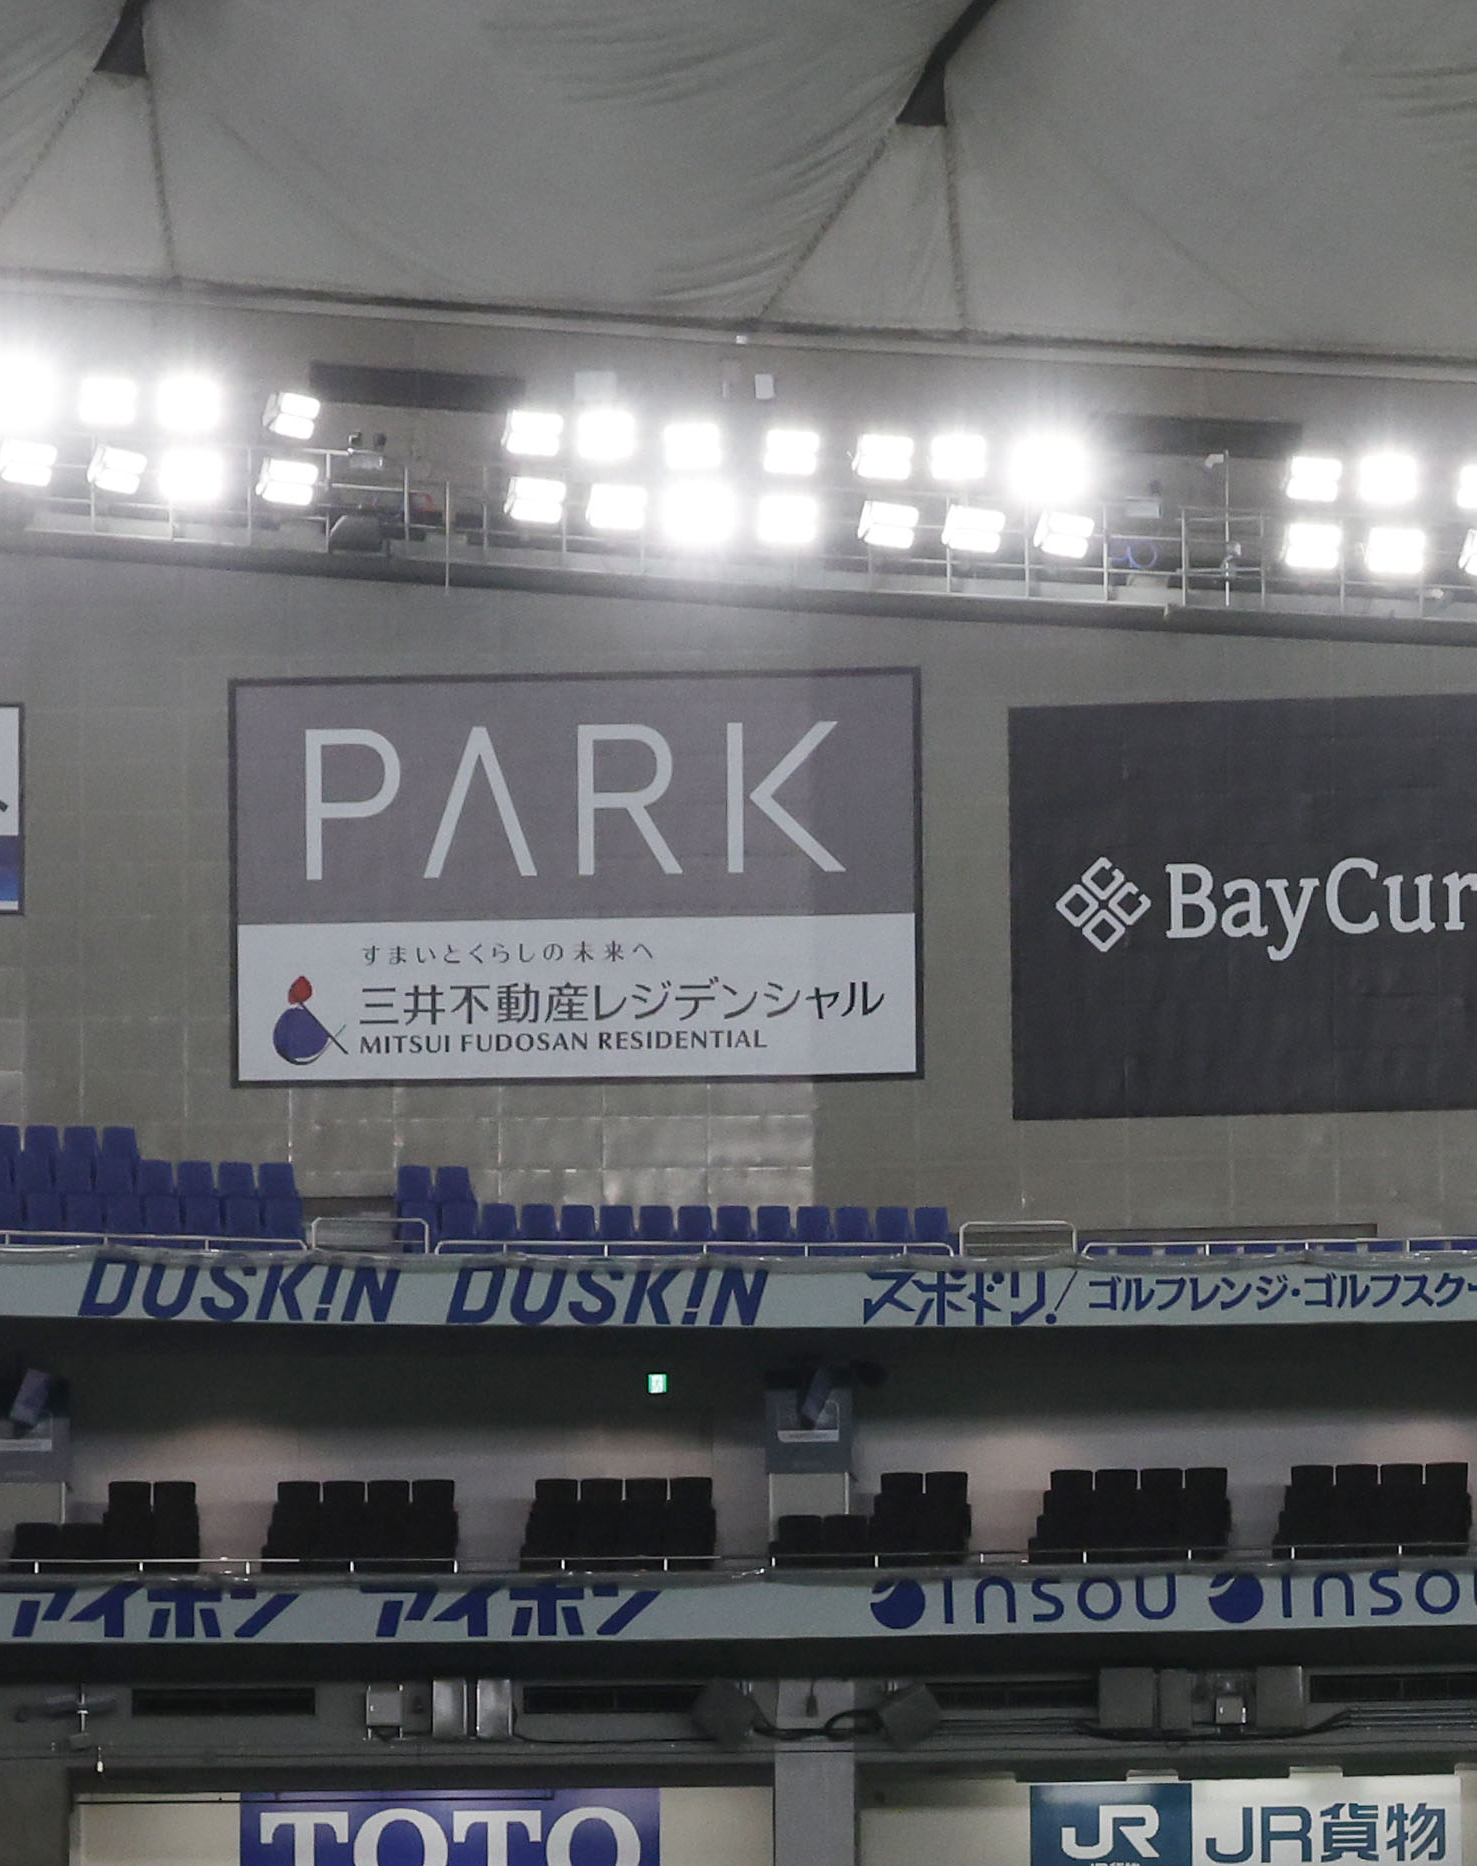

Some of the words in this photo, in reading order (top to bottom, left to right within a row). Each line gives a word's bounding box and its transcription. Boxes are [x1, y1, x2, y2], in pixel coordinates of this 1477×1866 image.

[305, 721, 846, 880] PARK
[360, 939, 654, 967] すまいとくらしの未来へ
[358, 975, 886, 1028] 三井不動産レジデンシャル
[359, 1034, 451, 1055] MITSUI
[460, 1032, 590, 1053] FUDOSAN
[597, 1029, 767, 1051] RESIDENTIAL
[1060, 1804, 1160, 1860] JR
[1205, 1801, 1447, 1864] JR貨物
